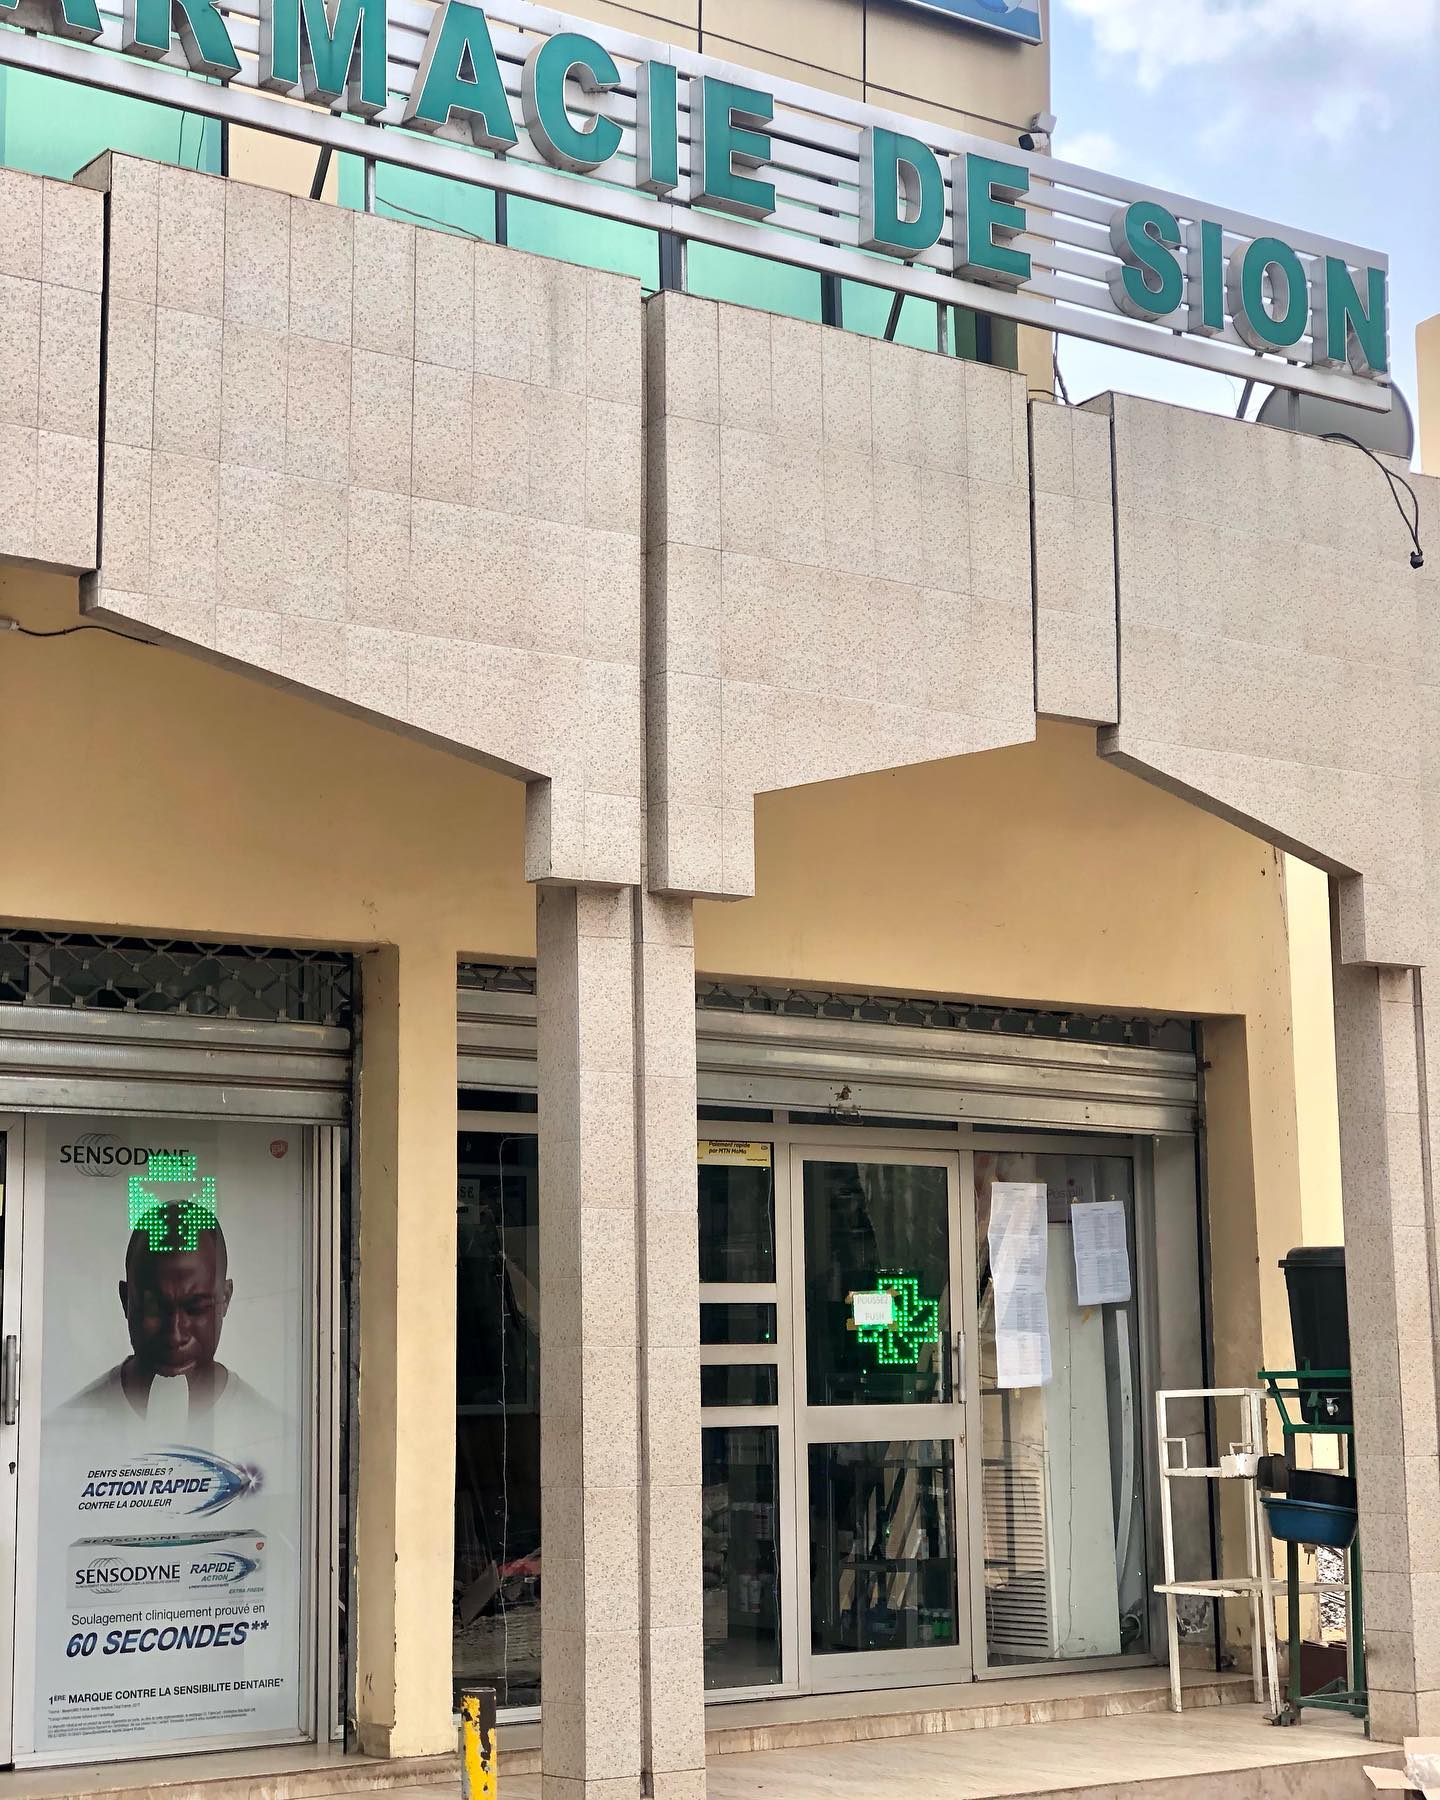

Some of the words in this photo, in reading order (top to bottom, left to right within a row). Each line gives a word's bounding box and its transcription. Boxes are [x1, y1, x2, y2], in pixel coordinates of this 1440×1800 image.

[0, 0, 776, 220] MACIE
[862, 127, 1031, 287] DE
[1112, 201, 1390, 378] SION
[60, 1144, 190, 1167] SENSODYNE
[88, 1470, 118, 1478] DENTS
[119, 1468, 166, 1477] SENSIBLES
[168, 1468, 174, 1476] ?
[81, 1480, 148, 1497] ACTION
[150, 1478, 211, 1494] RAPIDE
[78, 1501, 115, 1510] CONTRE
[116, 1500, 128, 1508] LA
[130, 1498, 172, 1508] DOULEUR
[76, 1564, 180, 1584] SENSODYNE
[190, 1562, 235, 1574] RAPIDE
[201, 1574, 228, 1582] ACTION
[72, 1611, 142, 1626] Soulagement
[146, 1608, 212, 1621] cliniquement
[214, 1604, 250, 1618] prouvé
[252, 1604, 265, 1613] en
[66, 1632, 98, 1658] 60
[68, 1692, 112, 1704] MARQUE
[115, 1688, 156, 1700] CONTRE
[159, 1687, 171, 1696] LA
[174, 1682, 231, 1695] SENSIBILITE
